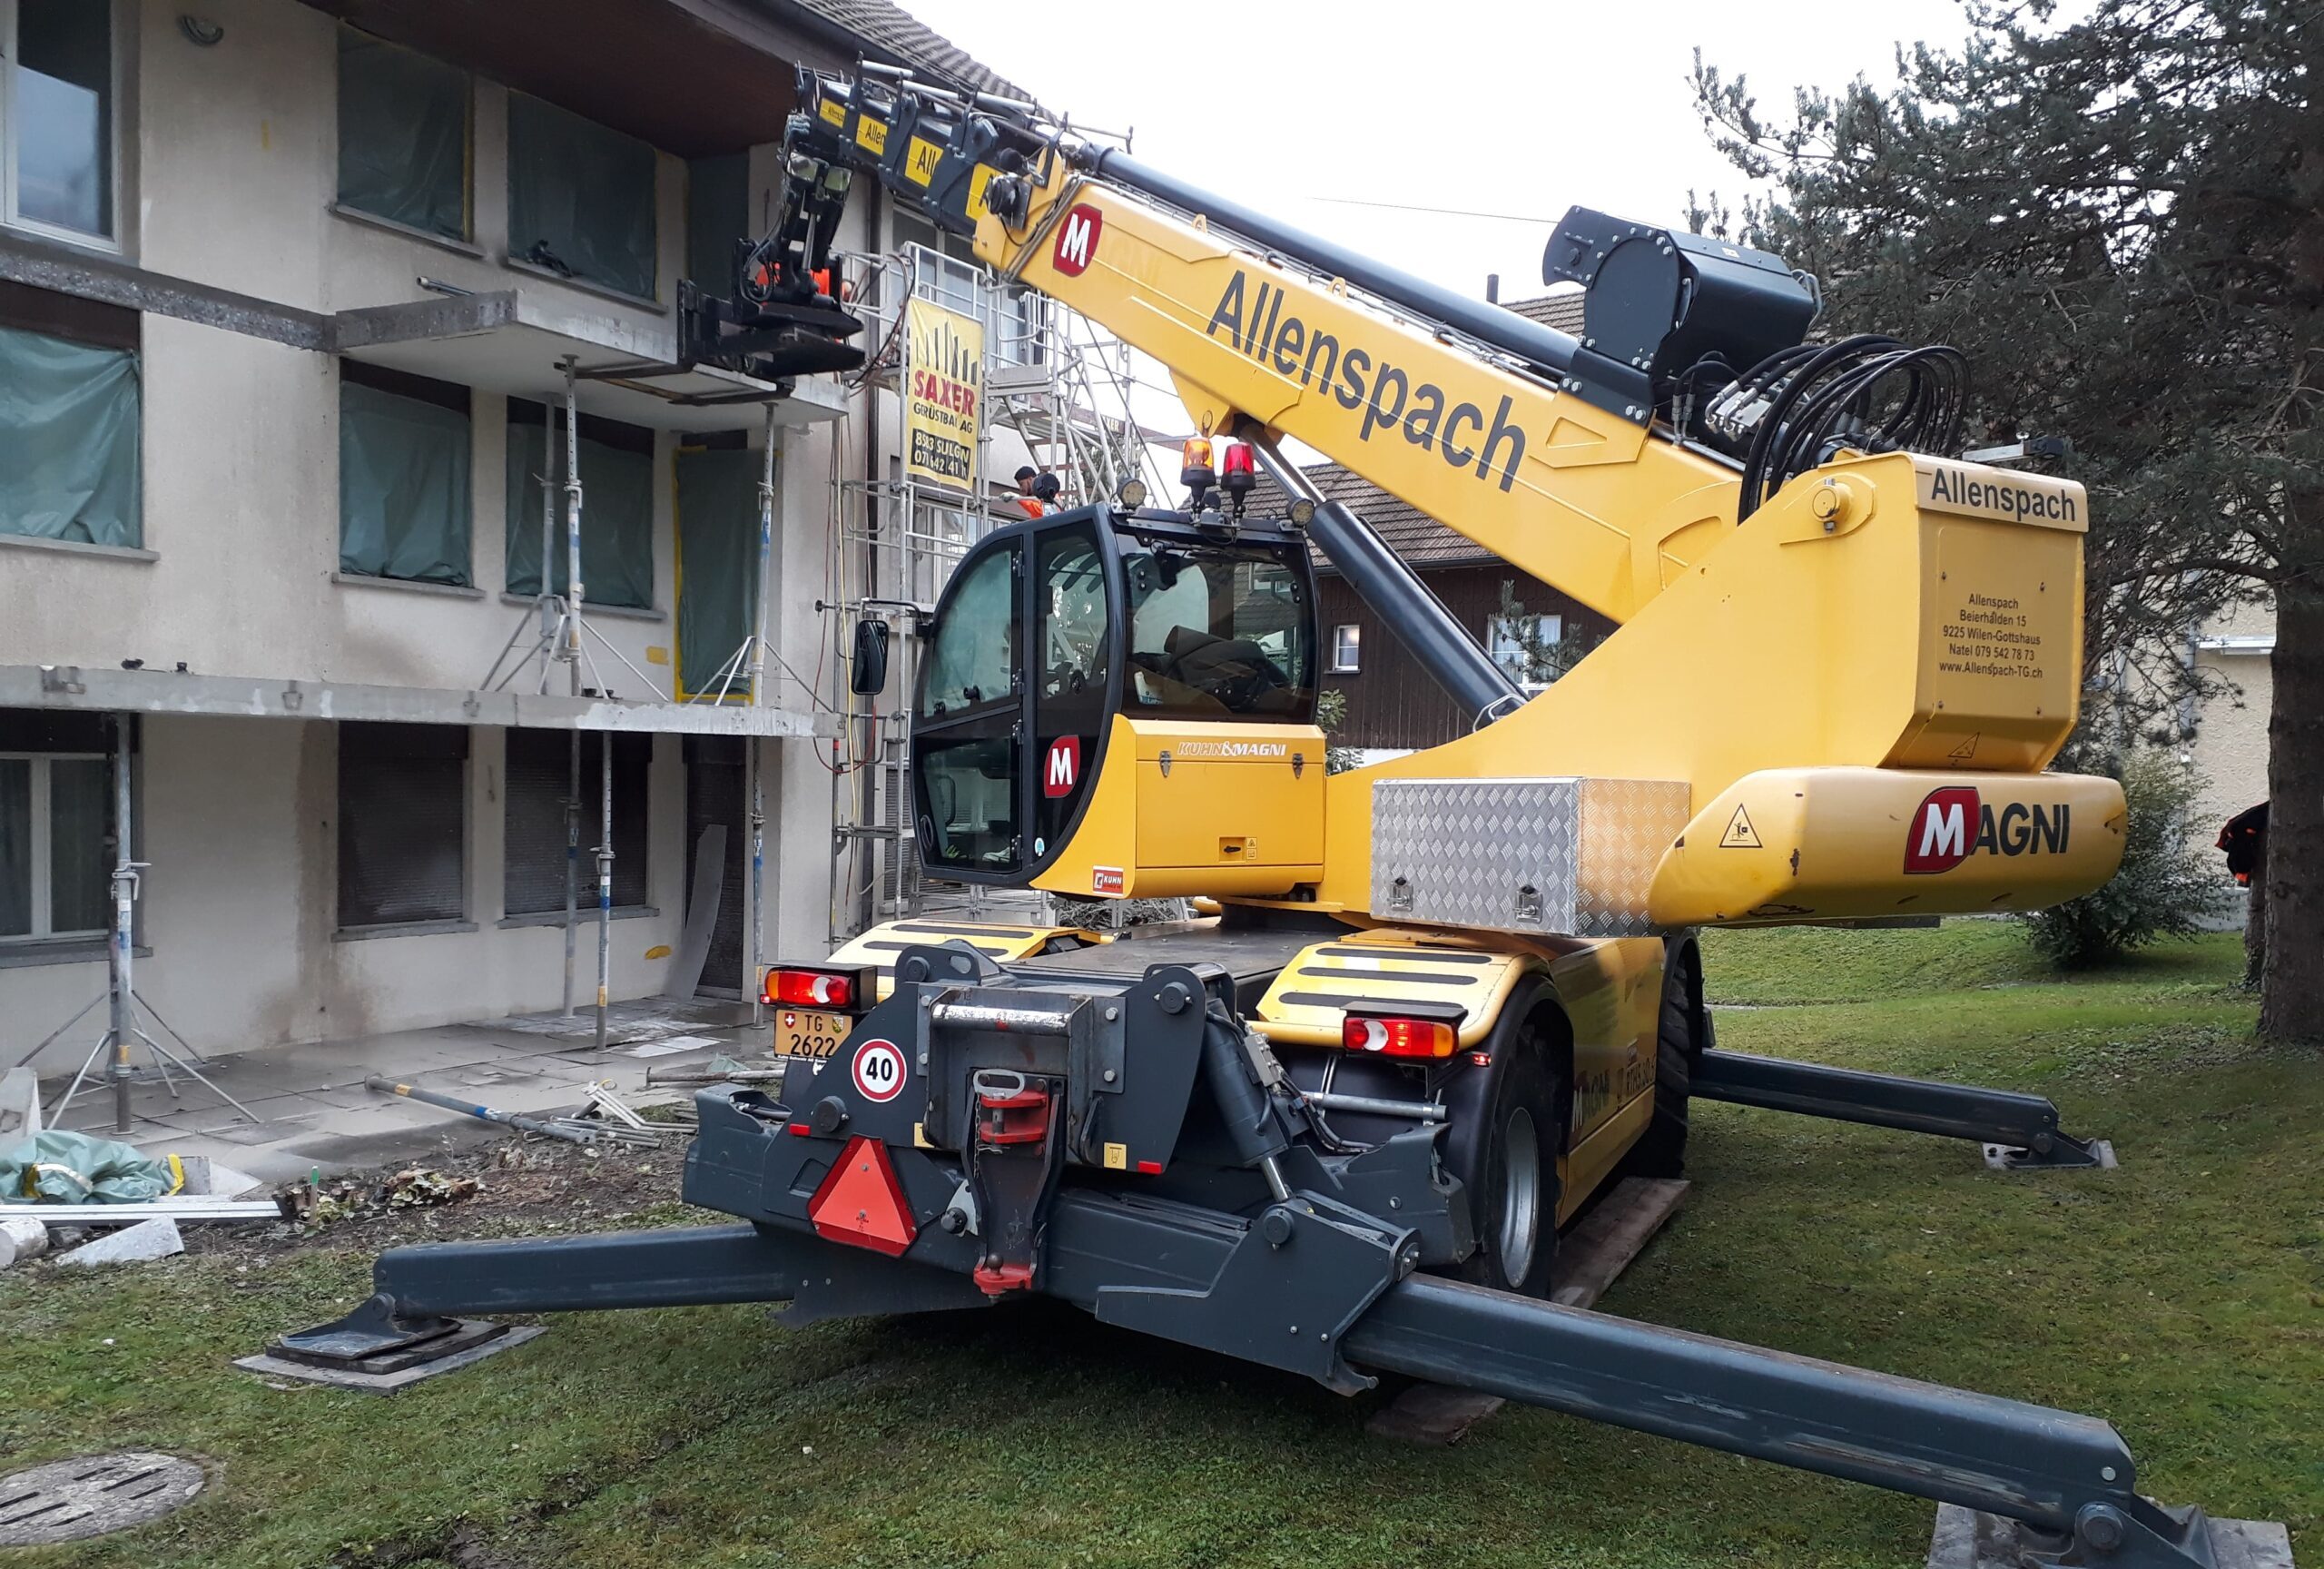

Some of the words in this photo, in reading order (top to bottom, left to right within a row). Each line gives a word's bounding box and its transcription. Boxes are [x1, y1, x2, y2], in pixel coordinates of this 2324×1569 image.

[1060, 213, 1091, 267] M
[1206, 270, 1526, 493] Allenspach
[914, 370, 975, 418] SAXER
[960, 419, 973, 434] AG
[1931, 468, 2076, 522] Allenspach
[1968, 593, 2019, 609] Allenspach
[2016, 616, 2026, 627] 15
[1943, 625, 1965, 638] 9225
[1967, 627, 2041, 646] Wilen-Gottshaus
[1949, 643, 1973, 656] Natel
[1975, 645, 1991, 657] 079
[1994, 646, 2009, 659] 542
[2012, 647, 2022, 660] 78
[2024, 649, 2034, 661] 73
[1939, 662, 2043, 678] www.Allenspach-TG.ch
[1177, 741, 1286, 756] KUHN&MAGNI
[1049, 747, 1073, 785] M
[1918, 803, 2071, 856] MAGNI
[1103, 875, 1122, 884] KUHN
[804, 1014, 822, 1031] TG
[790, 1033, 835, 1058] 2622
[865, 1058, 892, 1081] 40
